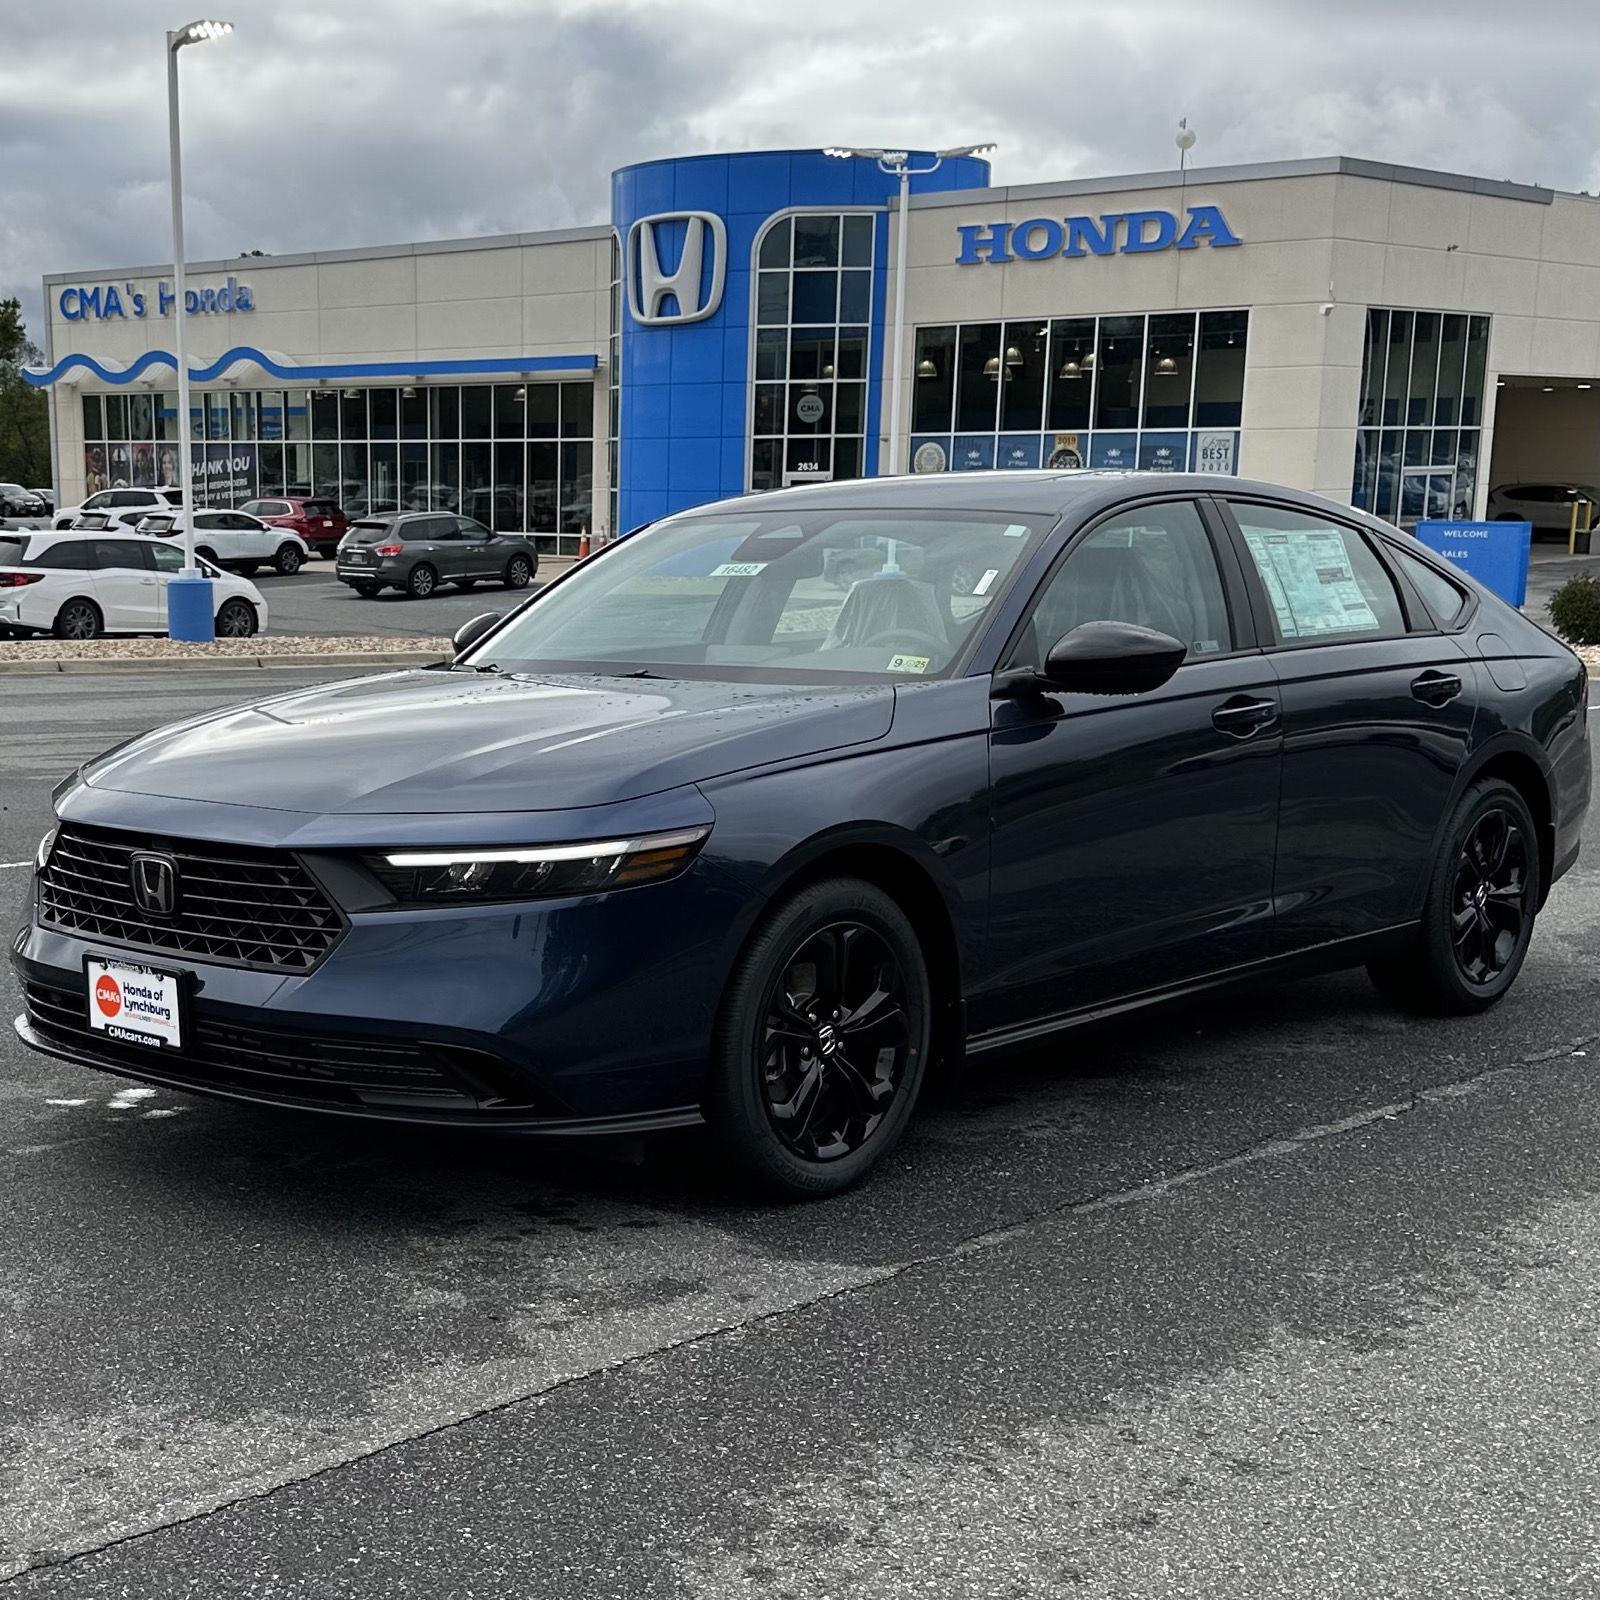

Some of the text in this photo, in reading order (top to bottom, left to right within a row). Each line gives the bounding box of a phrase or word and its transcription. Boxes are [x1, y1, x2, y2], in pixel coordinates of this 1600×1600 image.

[955, 205, 1244, 265] HONDA
[60, 276, 255, 321] CMA's Honda
[800, 404, 820, 413] CMA
[1057, 436, 1076, 445] 2019
[1202, 448, 1229, 460] BEST
[192, 455, 251, 476] HANK YOU
[797, 462, 819, 471] 2634
[1202, 462, 1230, 472] 2020
[1443, 530, 1489, 538] WELCOME
[1441, 550, 1469, 559] SALES
[893, 658, 903, 667] 9
[123, 981, 163, 1002] Honda of
[124, 997, 171, 1020] Lynchburg
[108, 1026, 161, 1048] CMAcars.com
